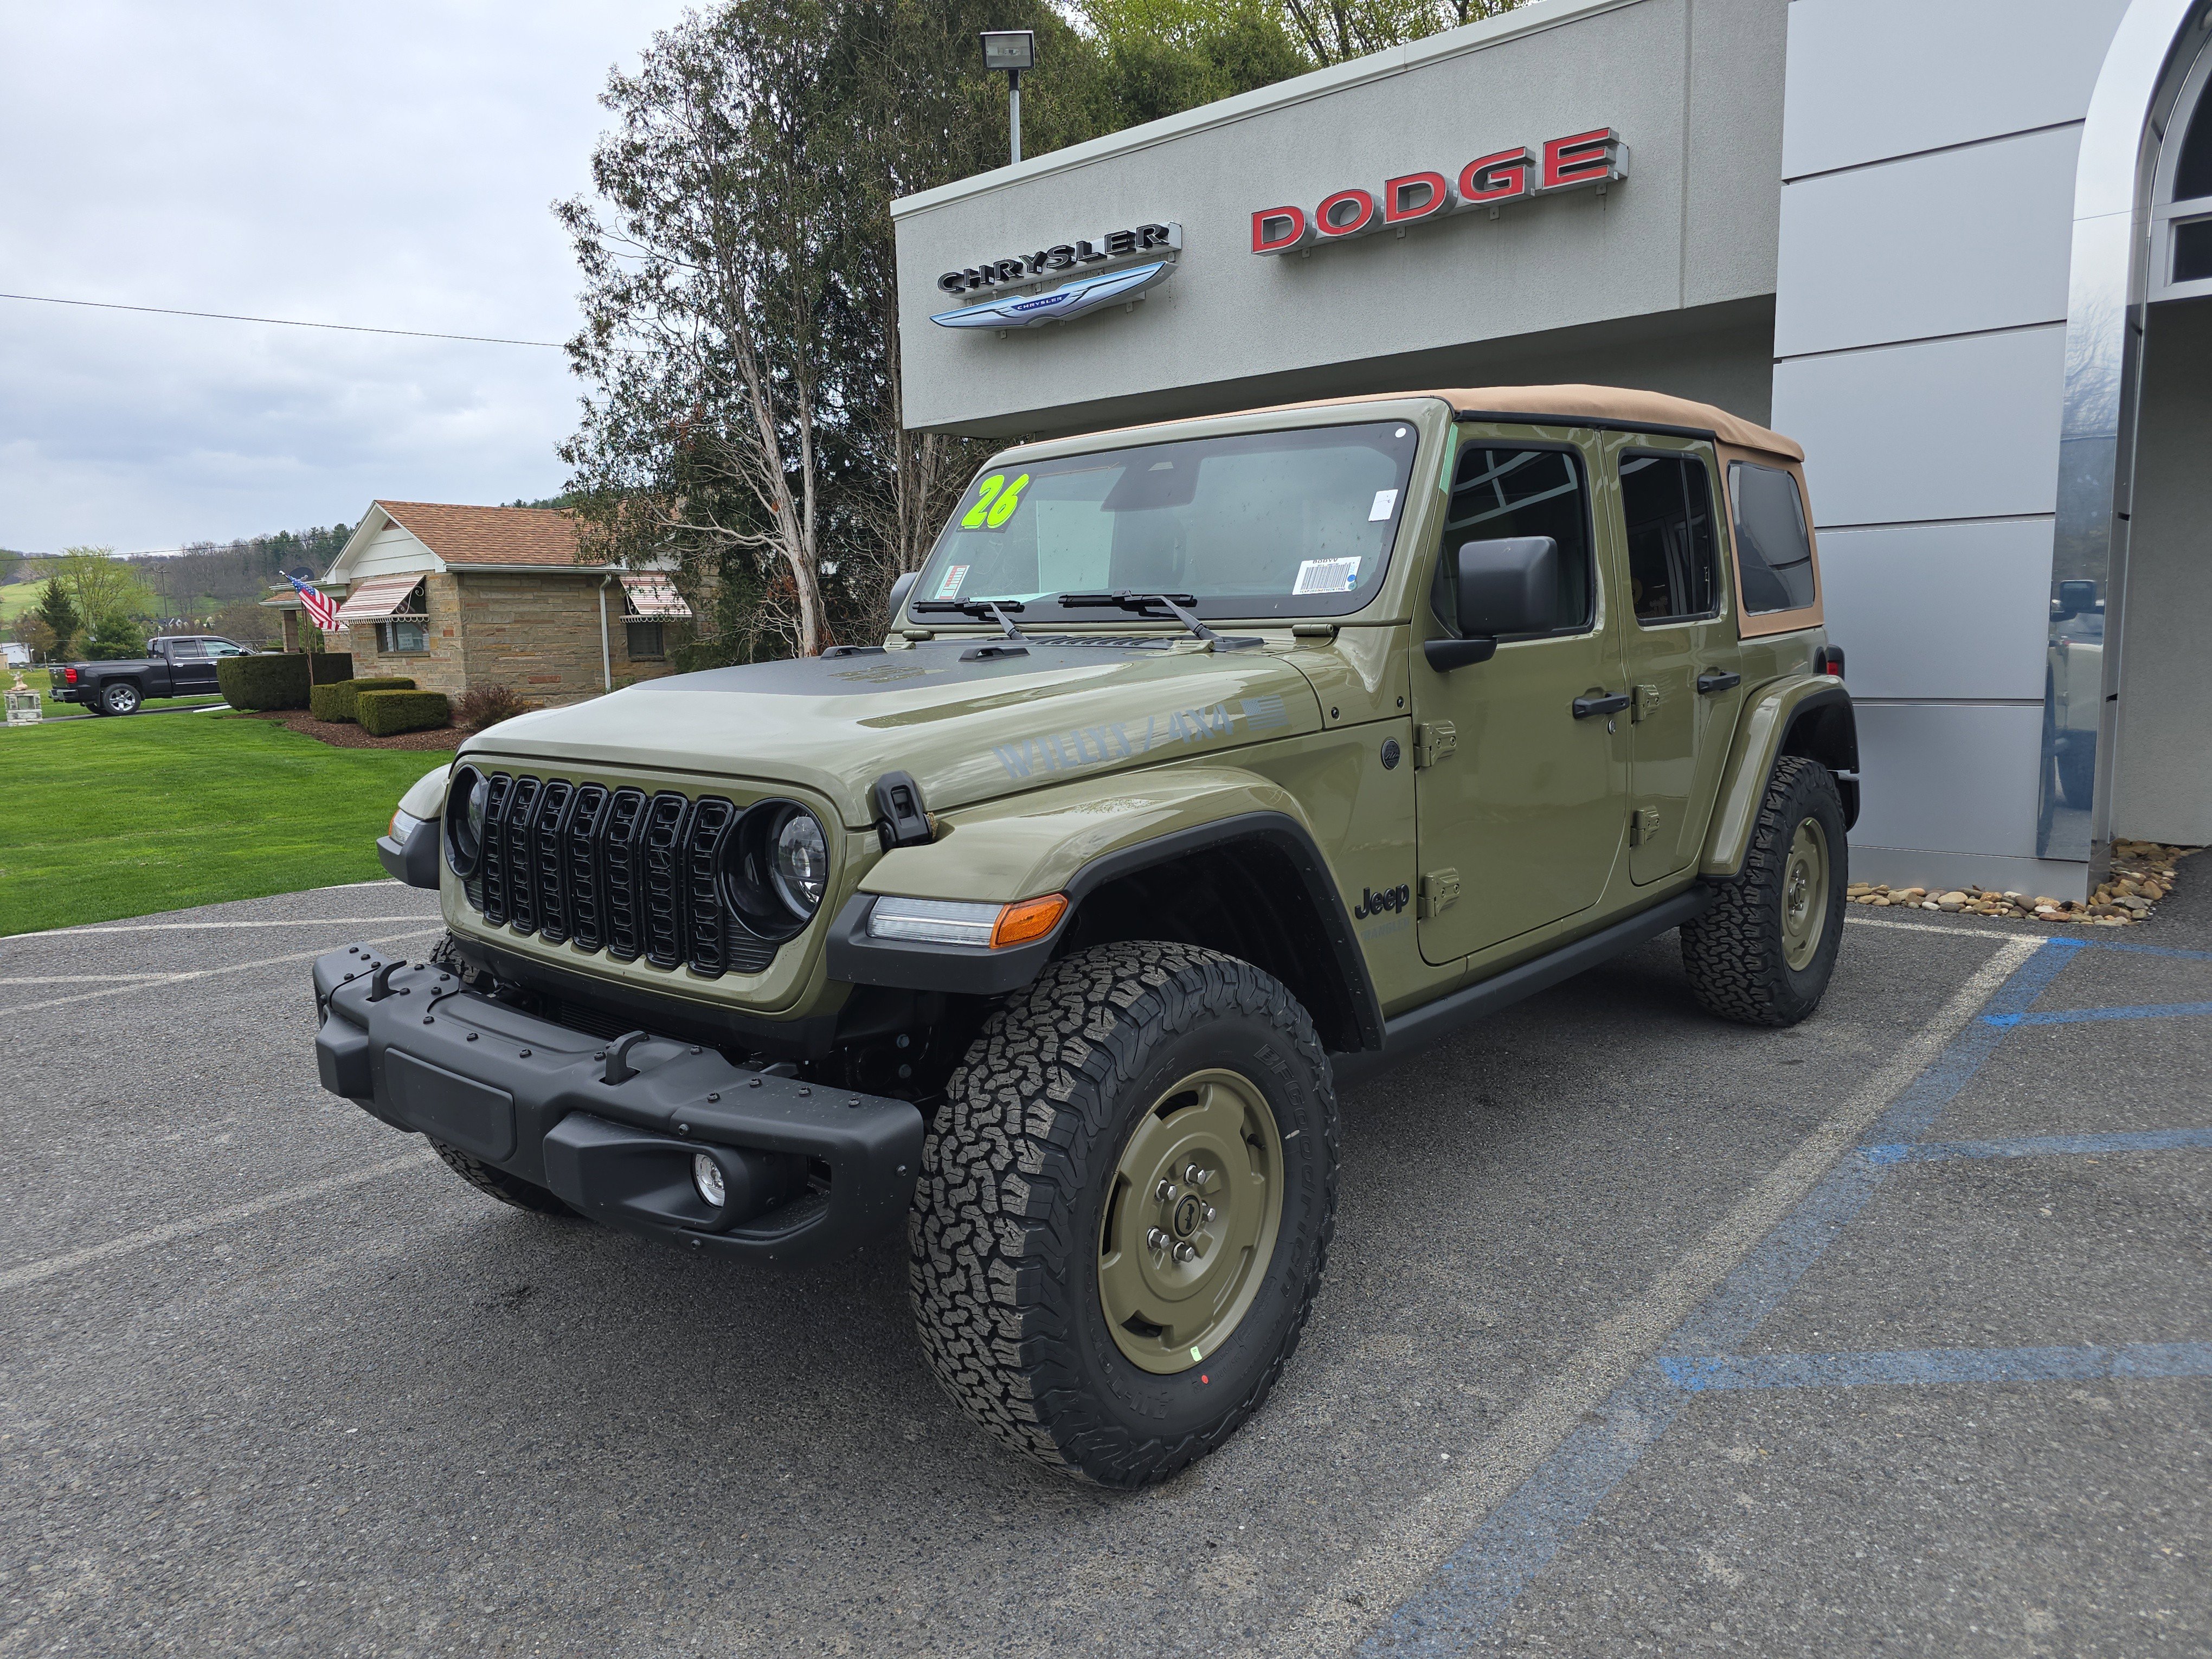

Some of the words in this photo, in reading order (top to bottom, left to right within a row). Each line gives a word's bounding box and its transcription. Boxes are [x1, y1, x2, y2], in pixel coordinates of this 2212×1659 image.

[1251, 127, 1618, 255] DODGE
[937, 224, 1169, 293] CHRYSLER
[1017, 297, 1063, 310] CHRYSLER
[961, 473, 1029, 529] 26
[991, 722, 1132, 780] WILLYS
[1354, 883, 1410, 920] Jeep
